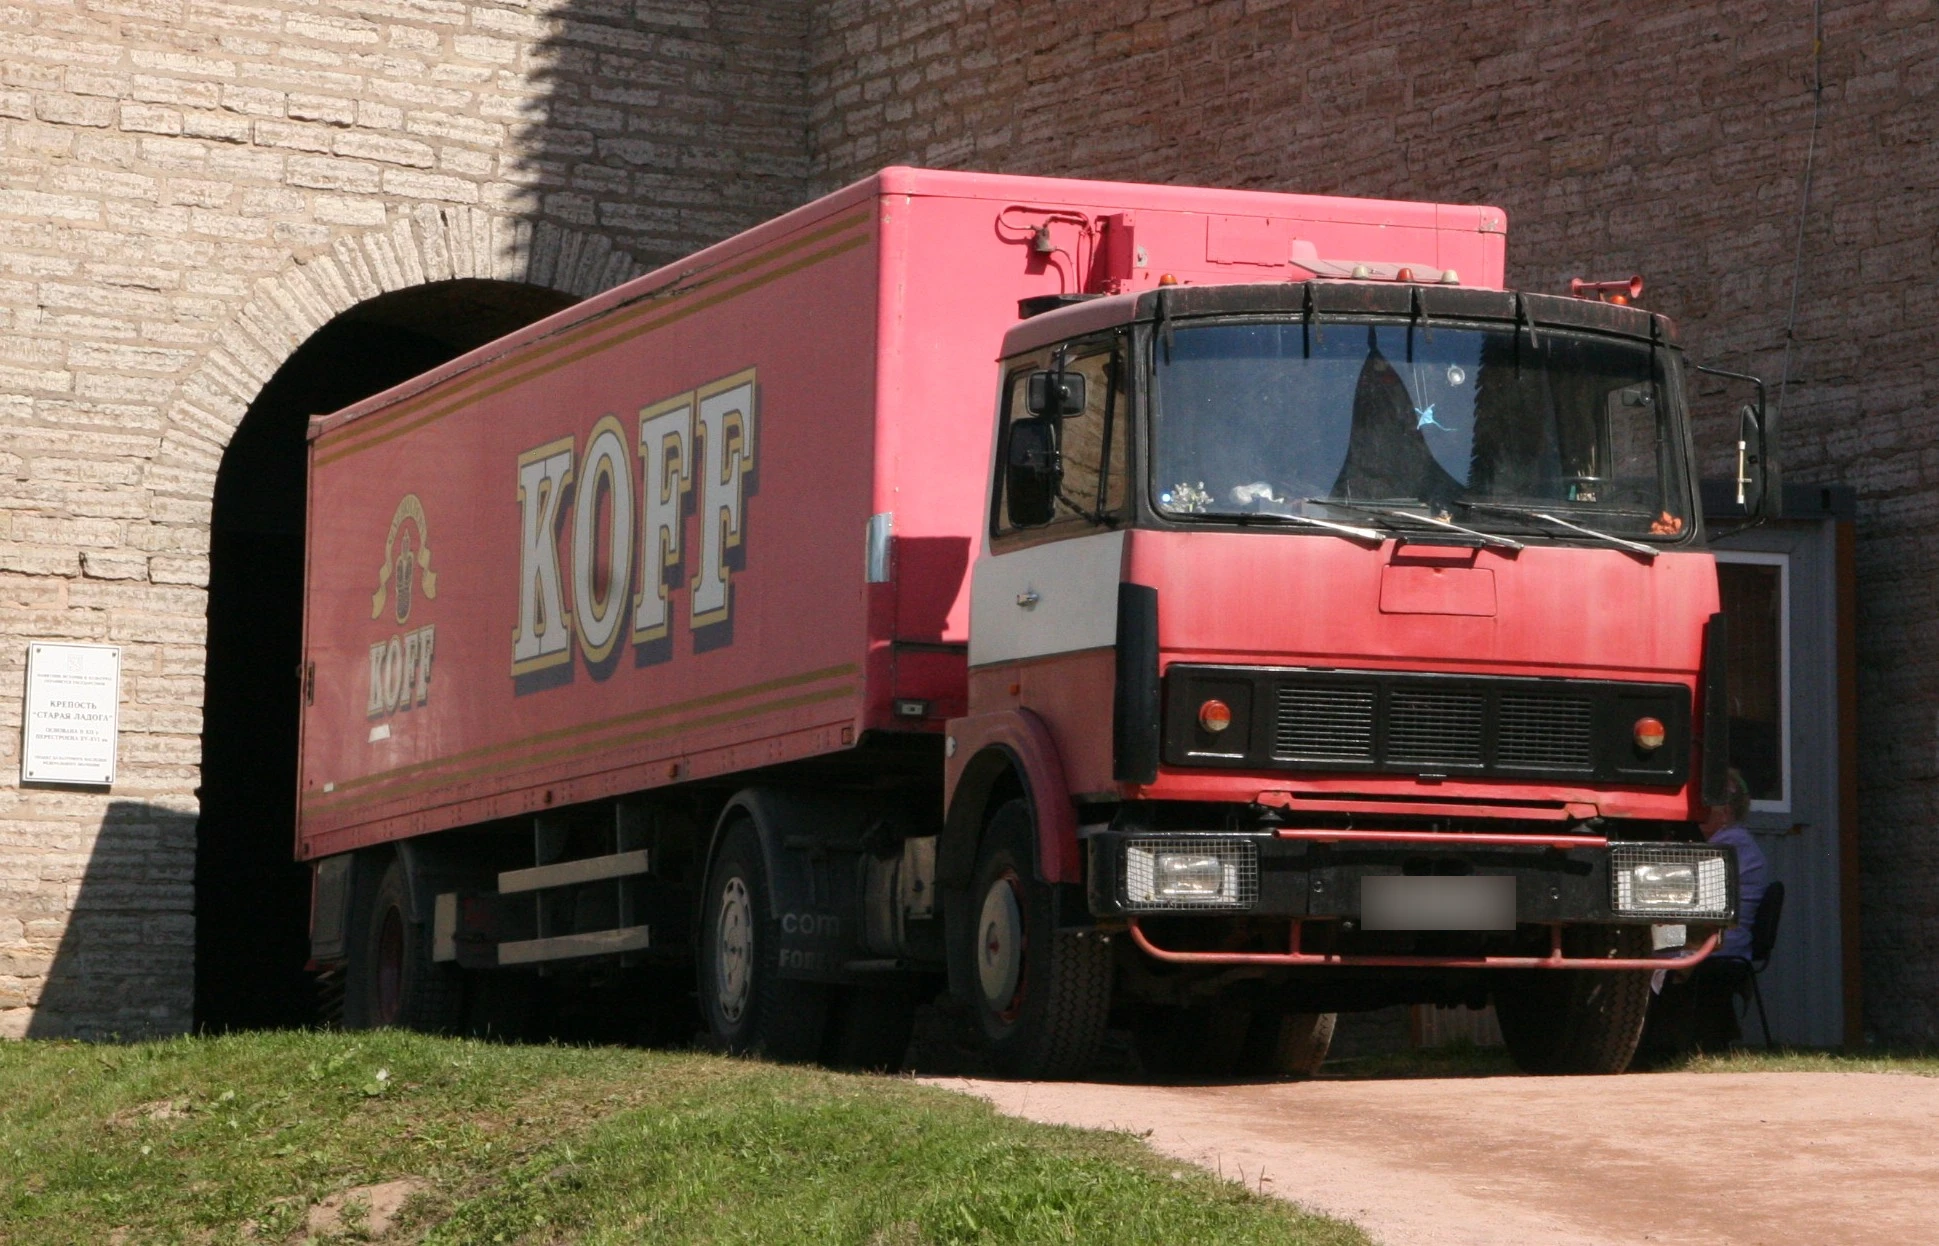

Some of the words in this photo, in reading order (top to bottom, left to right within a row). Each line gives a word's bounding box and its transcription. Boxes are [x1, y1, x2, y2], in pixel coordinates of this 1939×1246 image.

[511, 366, 761, 697] KOFF
[367, 624, 436, 720] KOFF
[33, 711, 71, 720] "СТАРАЯ
[74, 713, 113, 721] ЛАДОГА"
[50, 700, 97, 709] КРЕПОСТЬ
